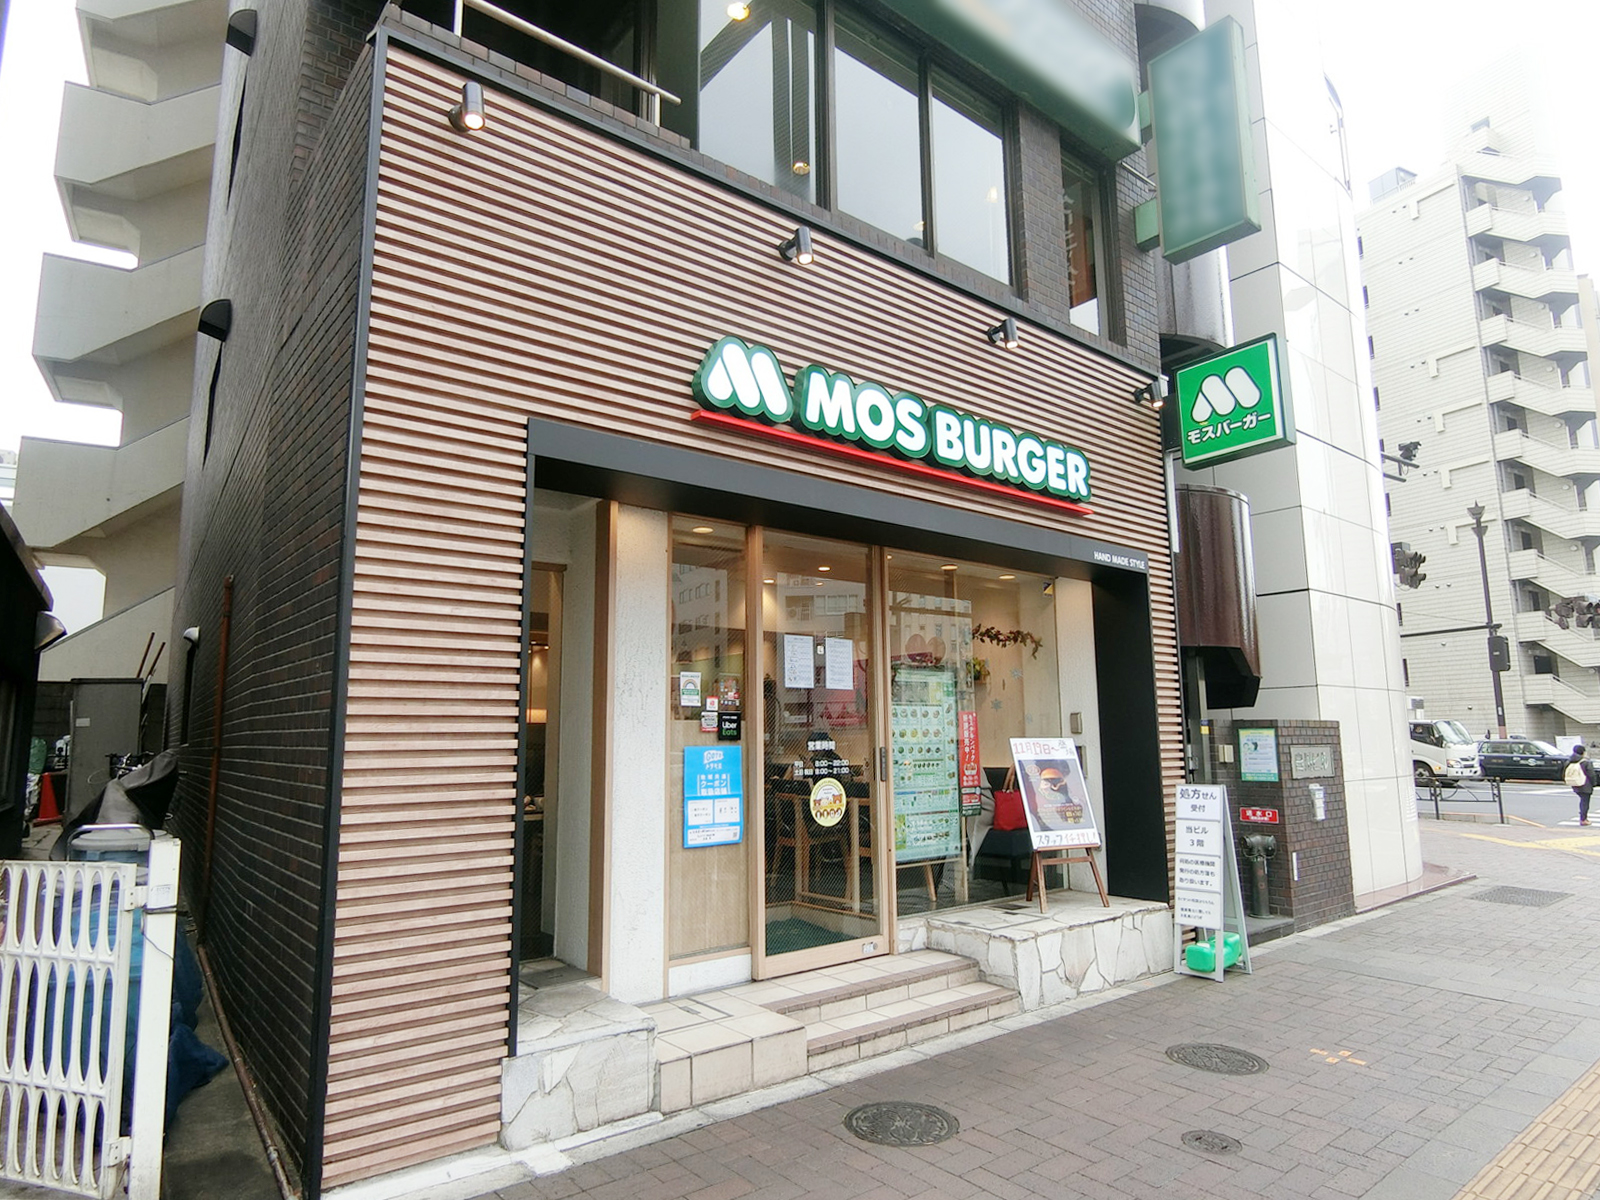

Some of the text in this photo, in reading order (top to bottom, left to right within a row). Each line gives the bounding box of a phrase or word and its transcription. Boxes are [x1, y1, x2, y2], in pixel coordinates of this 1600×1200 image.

[805, 371, 1089, 497] MOS BURGER
[1187, 412, 1272, 445] モスバーガー
[1093, 551, 1145, 569] HAND MADE STYLE
[722, 721, 738, 729] Uber
[807, 740, 836, 751] 営業時間
[700, 780, 727, 788] クーポン
[1180, 788, 1217, 800] 処方せん
[1190, 804, 1206, 813] 受付
[1185, 826, 1209, 835] 当ビル
